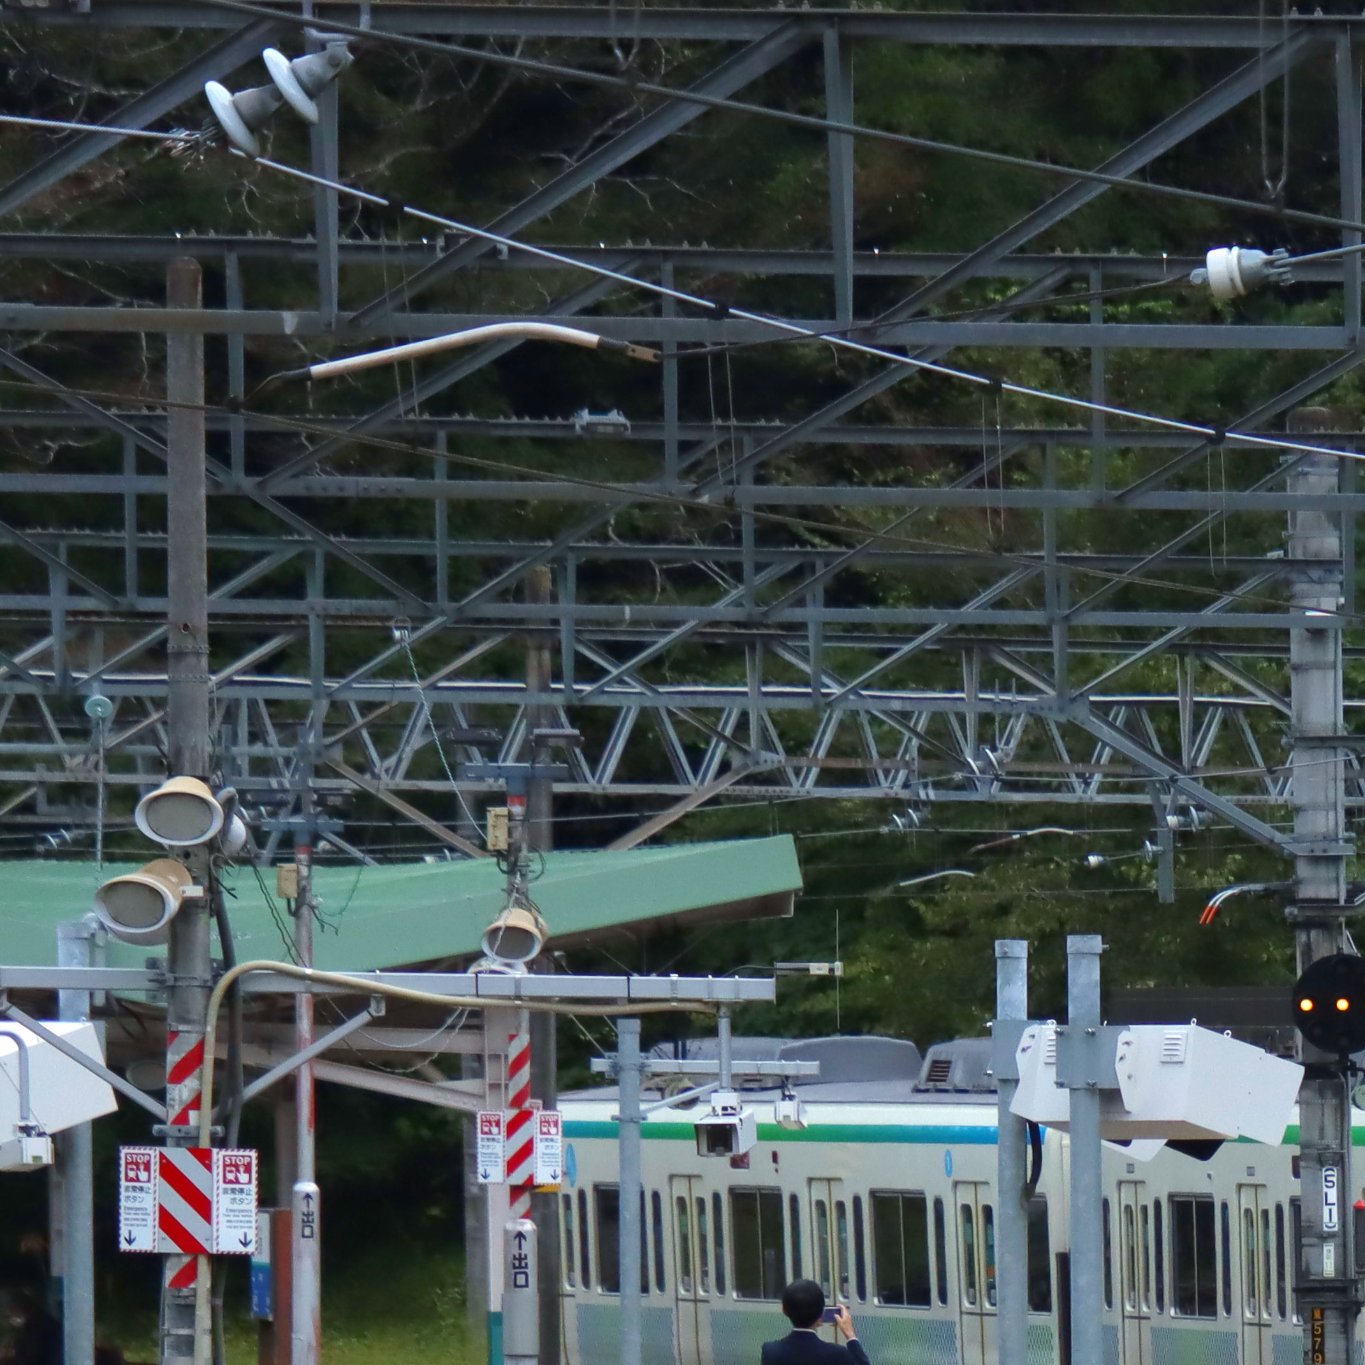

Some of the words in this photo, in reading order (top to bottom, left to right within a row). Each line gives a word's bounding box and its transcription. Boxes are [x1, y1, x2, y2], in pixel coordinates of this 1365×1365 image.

[126, 1154, 150, 1163] STOP
[224, 1156, 251, 1165] STOP
[302, 1211, 314, 1239] 出口
[513, 1252, 529, 1288] 出口
